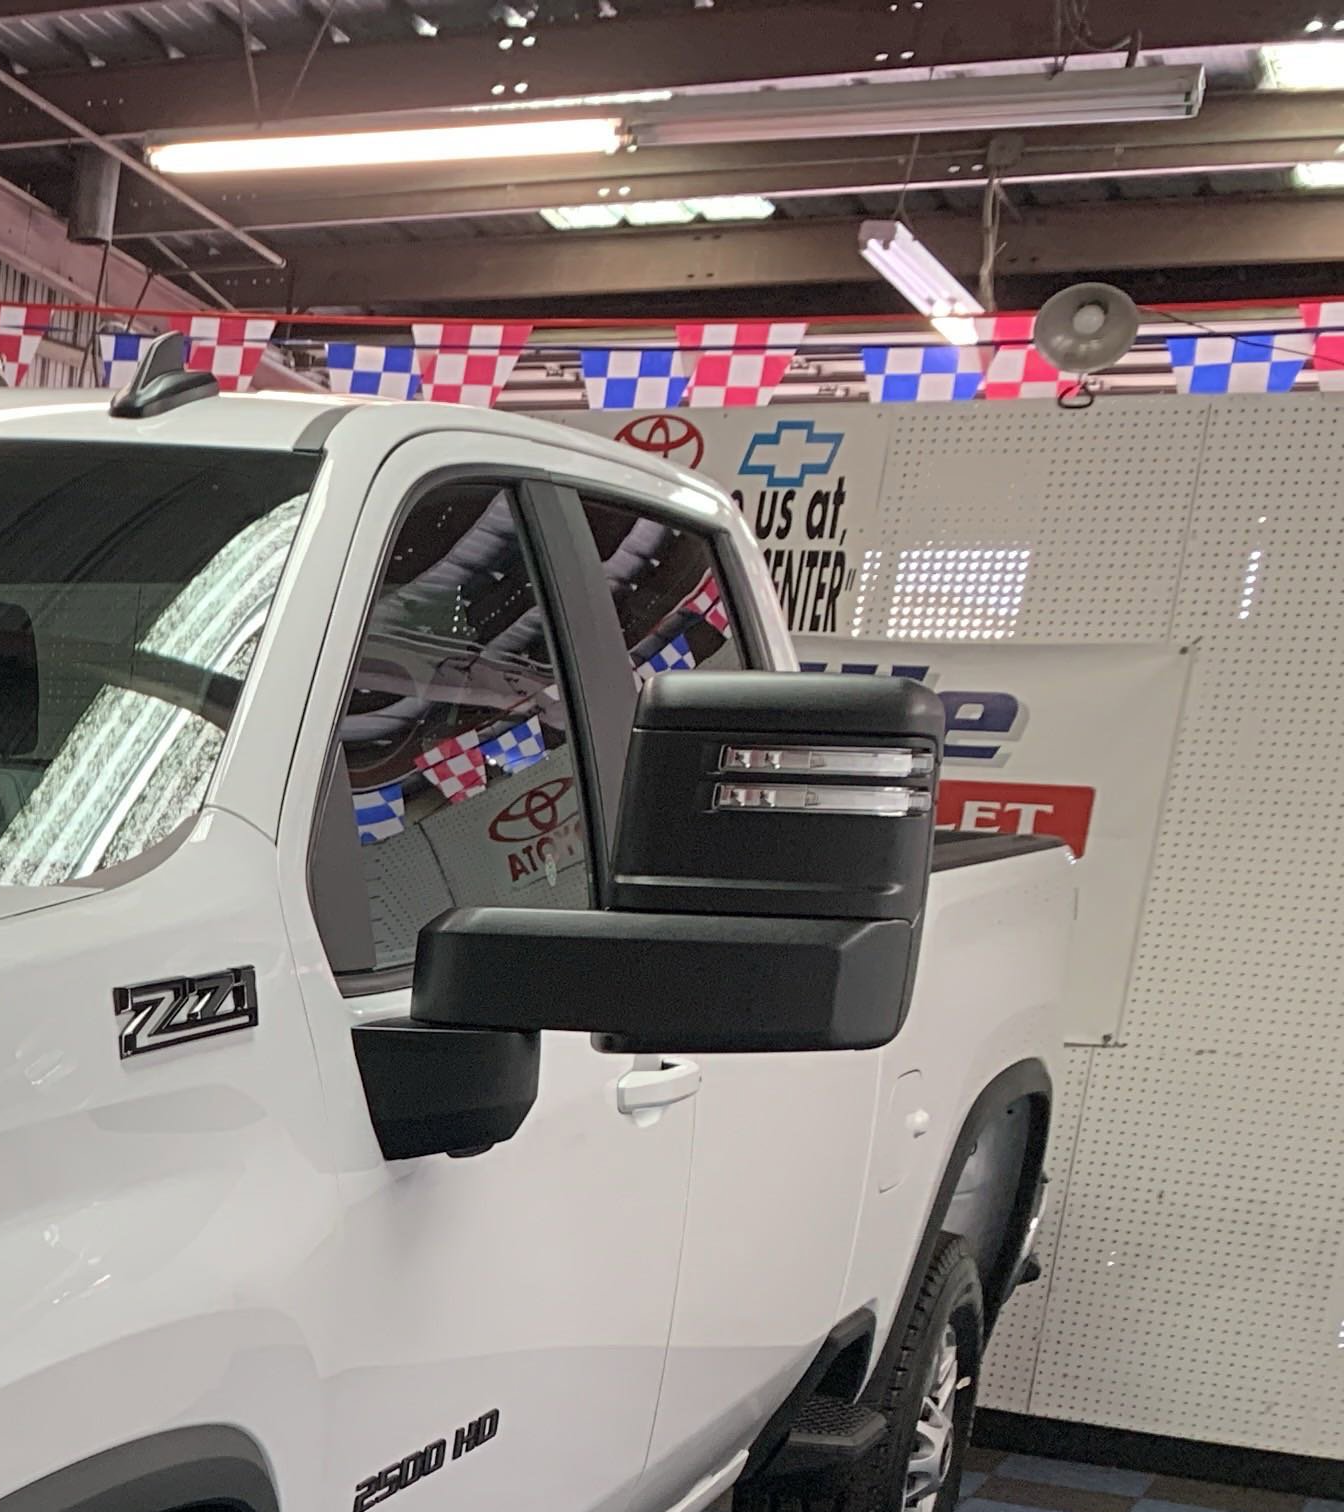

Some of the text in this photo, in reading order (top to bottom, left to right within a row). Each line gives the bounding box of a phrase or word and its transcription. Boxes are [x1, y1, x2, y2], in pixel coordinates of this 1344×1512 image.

[755, 489, 796, 540] us
[805, 476, 847, 546] at,
[112, 964, 258, 1060] Z71
[452, 1408, 499, 1461] HD
